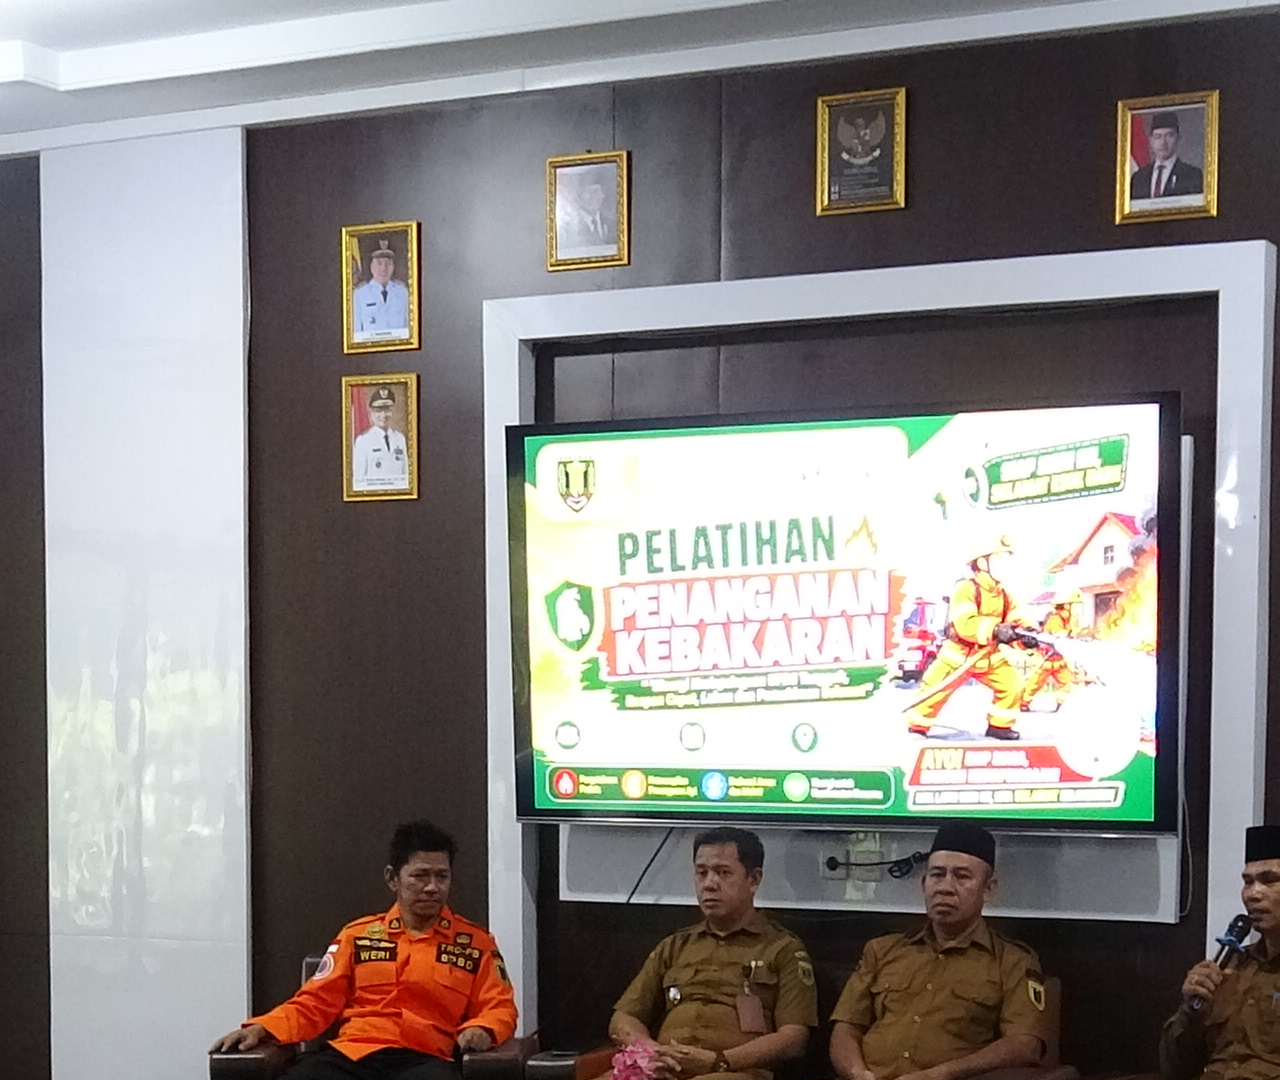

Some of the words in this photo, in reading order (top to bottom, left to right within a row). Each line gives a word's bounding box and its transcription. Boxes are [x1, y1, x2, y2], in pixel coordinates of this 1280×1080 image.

[617, 515, 835, 576] PELATIHAN
[610, 569, 890, 631] PENANGANAN
[615, 614, 886, 676] KEBAKARAN
[360, 950, 390, 961] WERI
